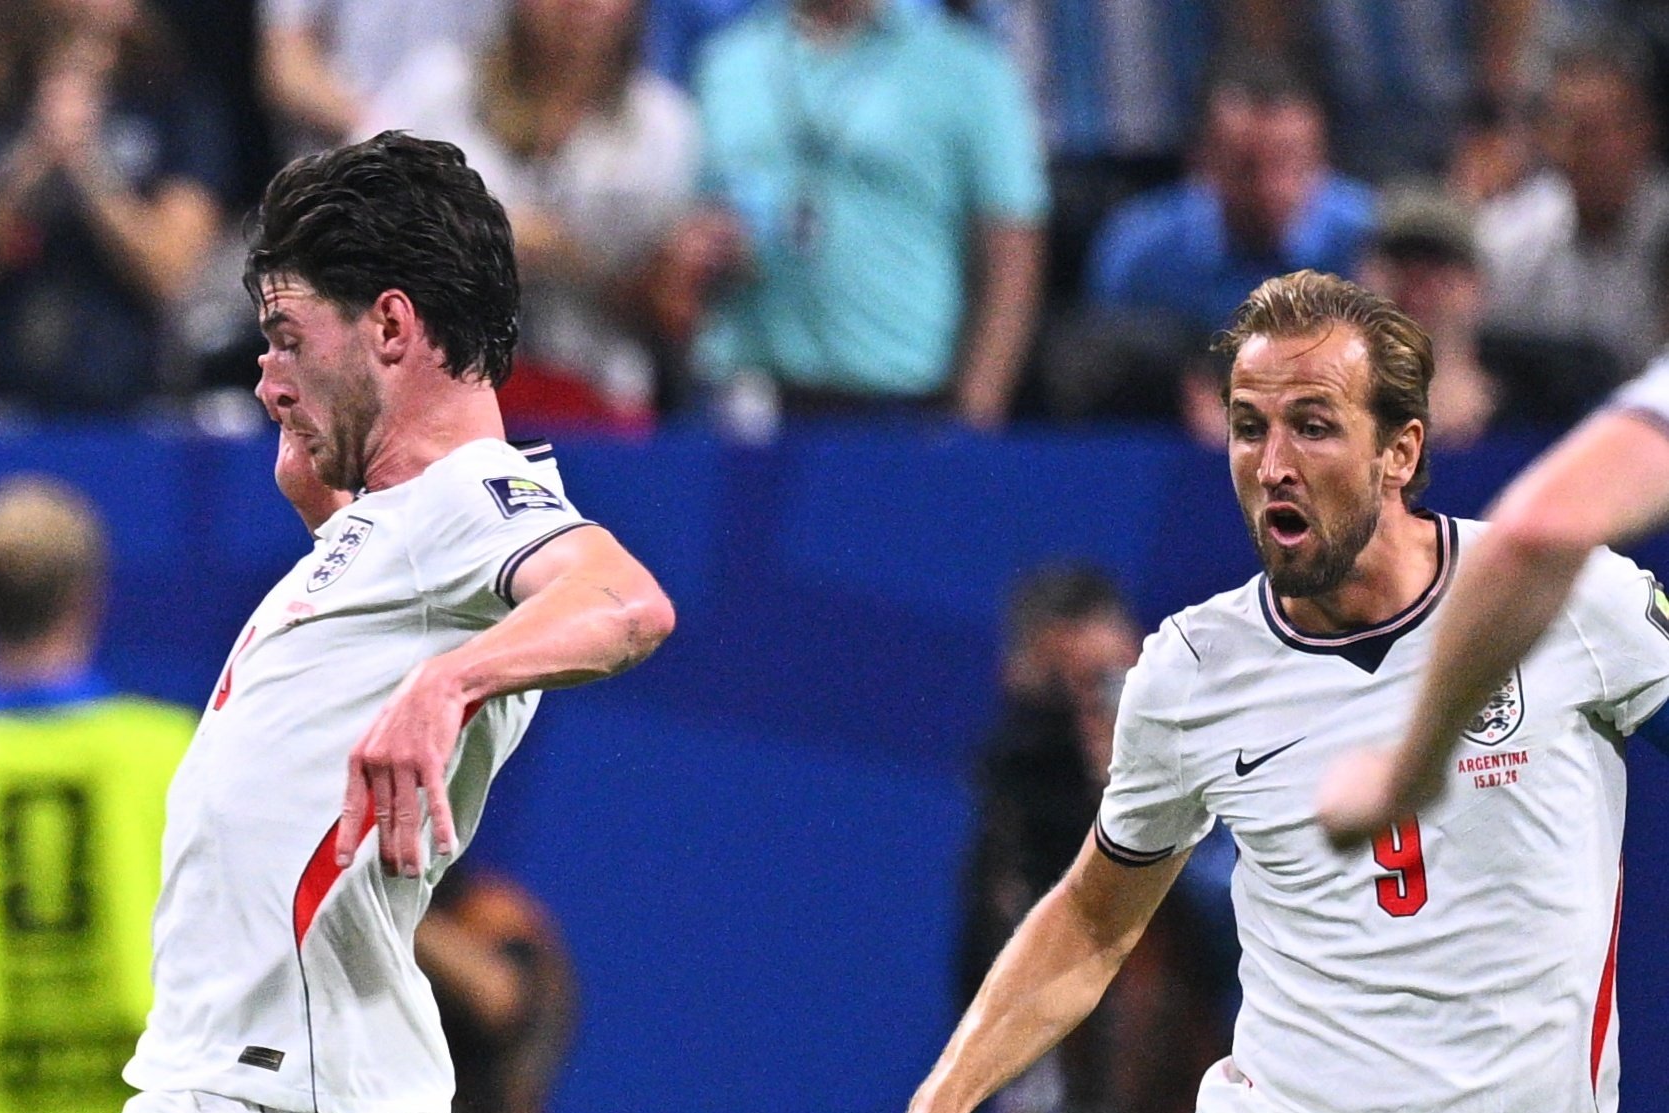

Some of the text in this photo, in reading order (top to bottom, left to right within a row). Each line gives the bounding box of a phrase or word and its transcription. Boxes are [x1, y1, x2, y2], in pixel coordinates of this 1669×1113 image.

[1458, 751, 1528, 773] ARGENTINA
[1474, 770, 1518, 789] 15.07.26
[1371, 812, 1428, 917] 9
